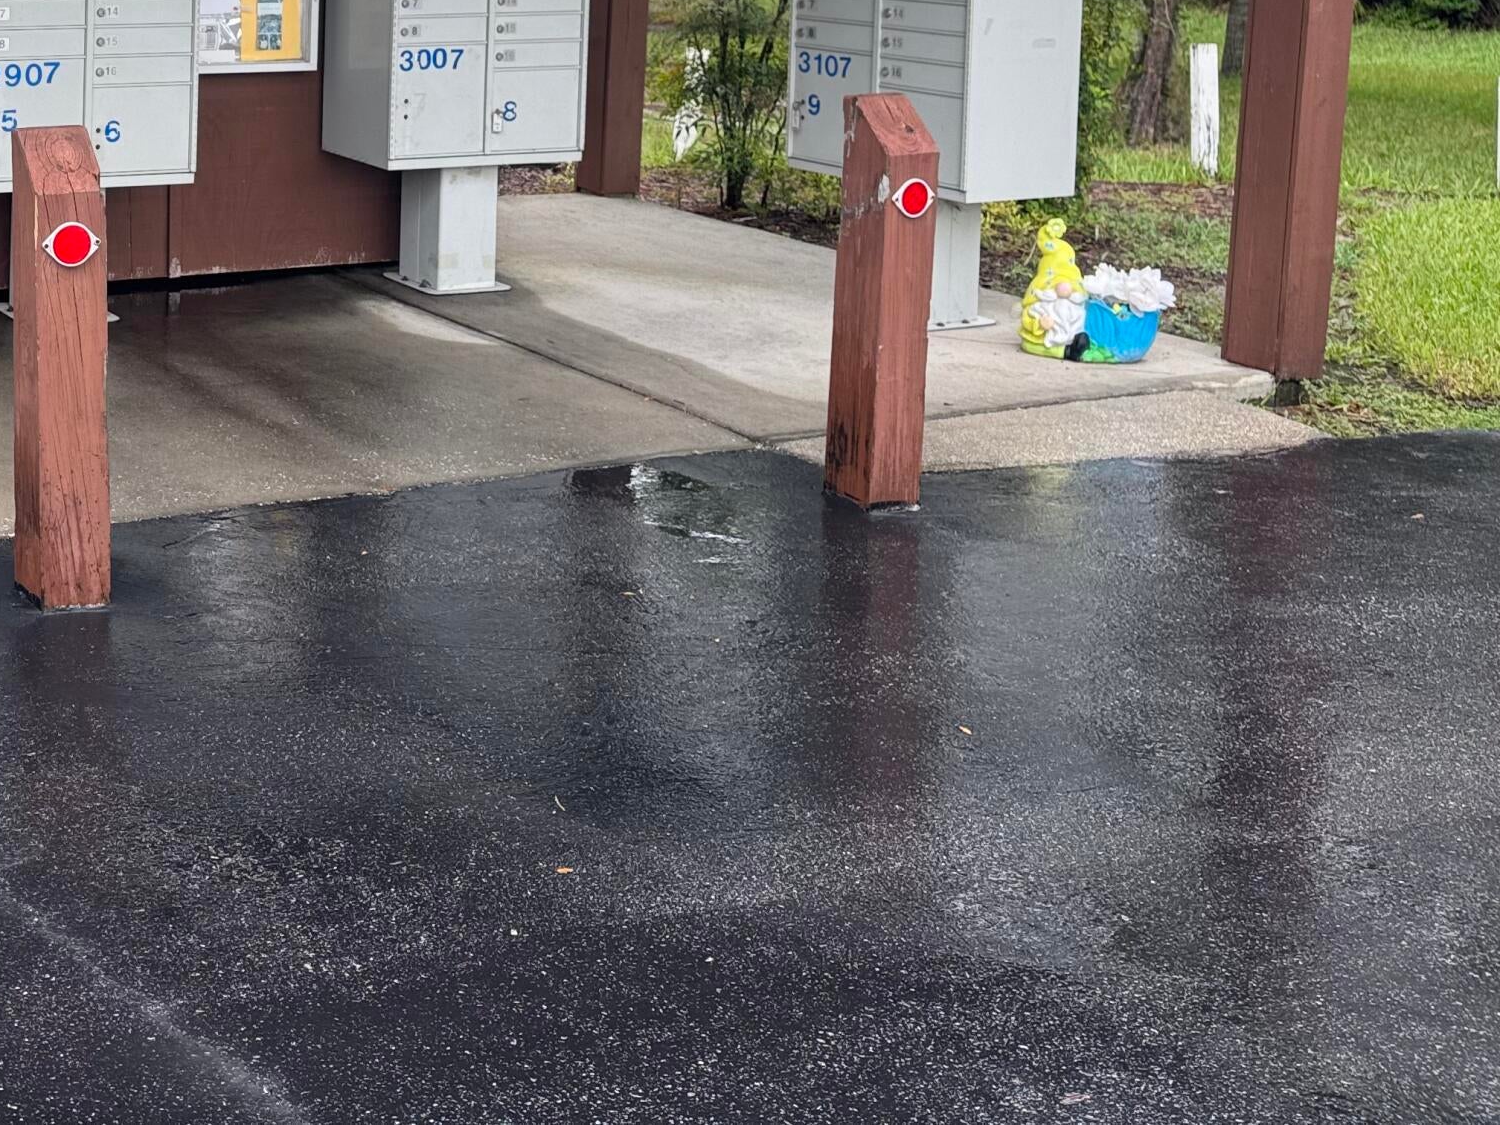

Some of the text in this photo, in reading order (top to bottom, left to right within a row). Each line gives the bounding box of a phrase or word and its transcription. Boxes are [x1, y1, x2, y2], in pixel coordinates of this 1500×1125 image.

[106, 7, 119, 17] 14
[106, 37, 119, 47] 15
[399, 47, 465, 72] 3007
[798, 50, 852, 79] 3107
[105, 66, 118, 77] 16
[502, 100, 518, 122] 8
[807, 93, 821, 116] 9
[1, 109, 18, 133] 5
[104, 119, 121, 143] 6
